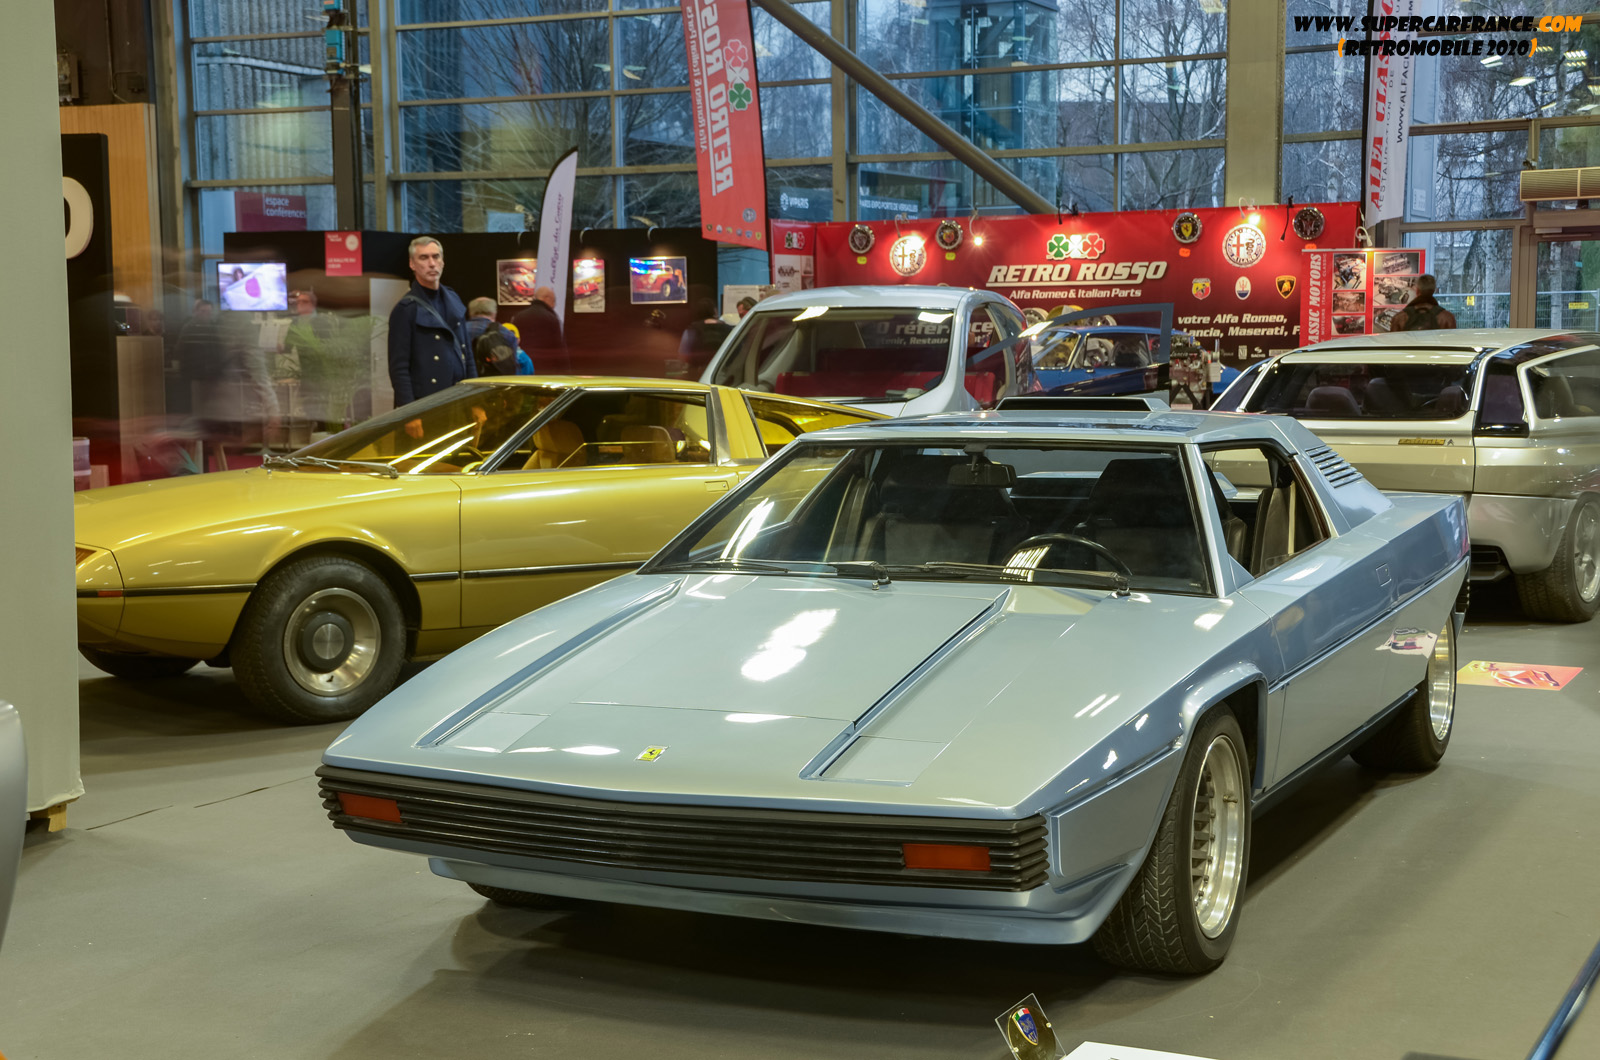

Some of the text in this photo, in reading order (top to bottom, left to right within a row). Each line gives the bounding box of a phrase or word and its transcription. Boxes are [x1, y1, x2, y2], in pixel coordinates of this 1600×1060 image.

[1370, 136, 1383, 209] ALFA
[265, 196, 289, 207] espace
[988, 261, 1168, 284] RETRO ROSSO
[1309, 253, 1322, 307] MOTORS
[1009, 288, 1142, 300] Alfa Romeo & Italian Parts
[1177, 313, 1288, 325] votre Alfa Romeo,
[1308, 308, 1320, 345] ASSIC
[1227, 325, 1289, 337] Maserati,
[1291, 325, 1301, 336] F
